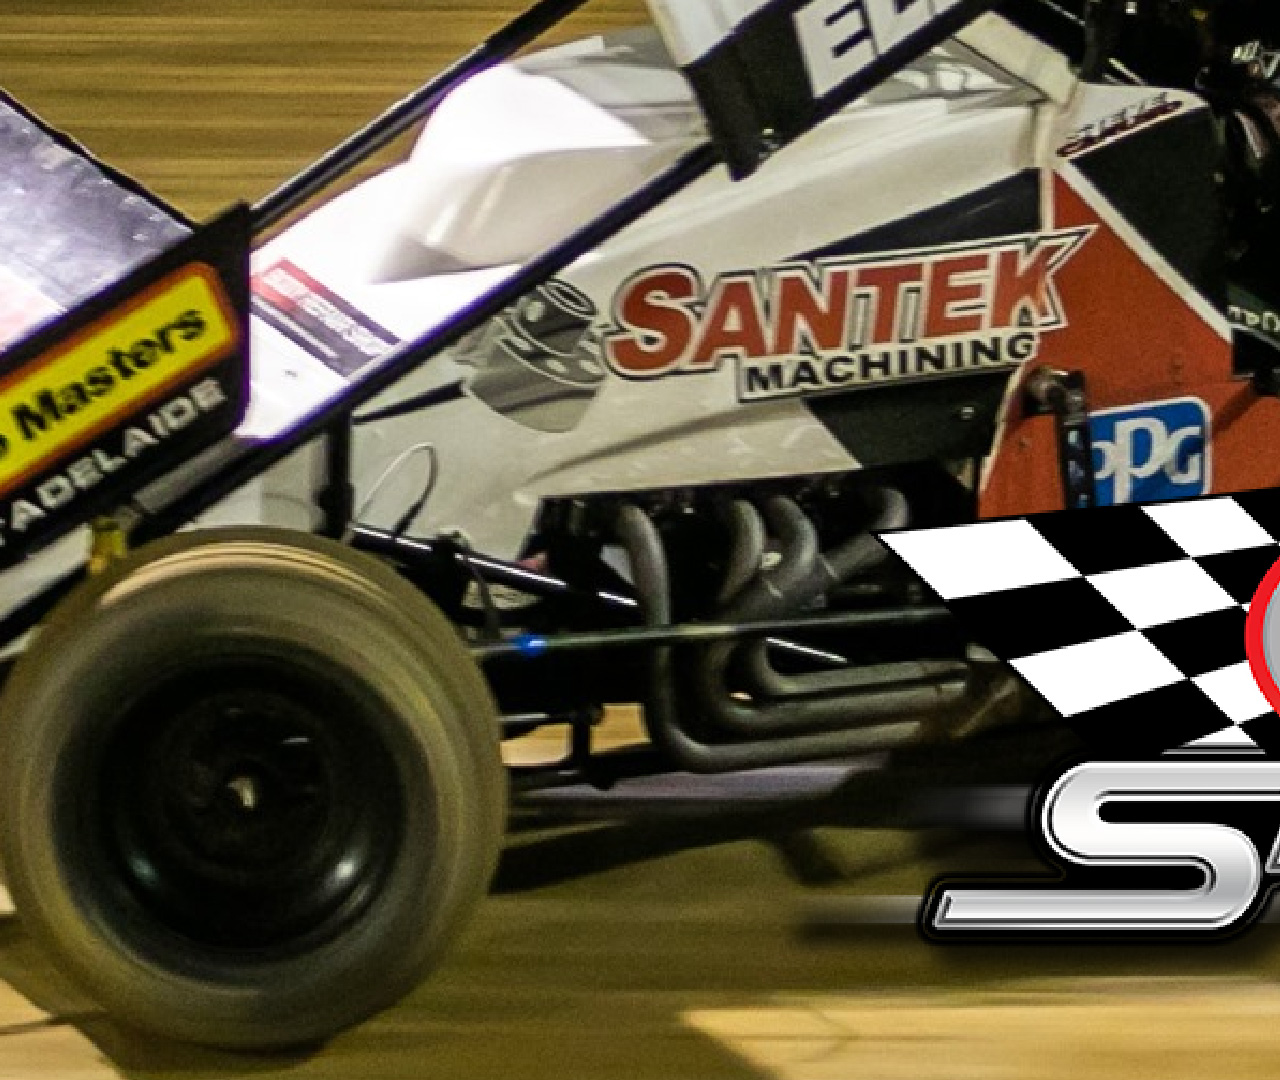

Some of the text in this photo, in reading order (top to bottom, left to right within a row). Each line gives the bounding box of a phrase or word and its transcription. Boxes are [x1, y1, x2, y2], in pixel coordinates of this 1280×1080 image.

[606, 228, 1090, 380] SANTEK
[744, 332, 1038, 395] MACHINING
[10, 309, 207, 444] Masters
[9, 377, 228, 532] ADELAIDE
